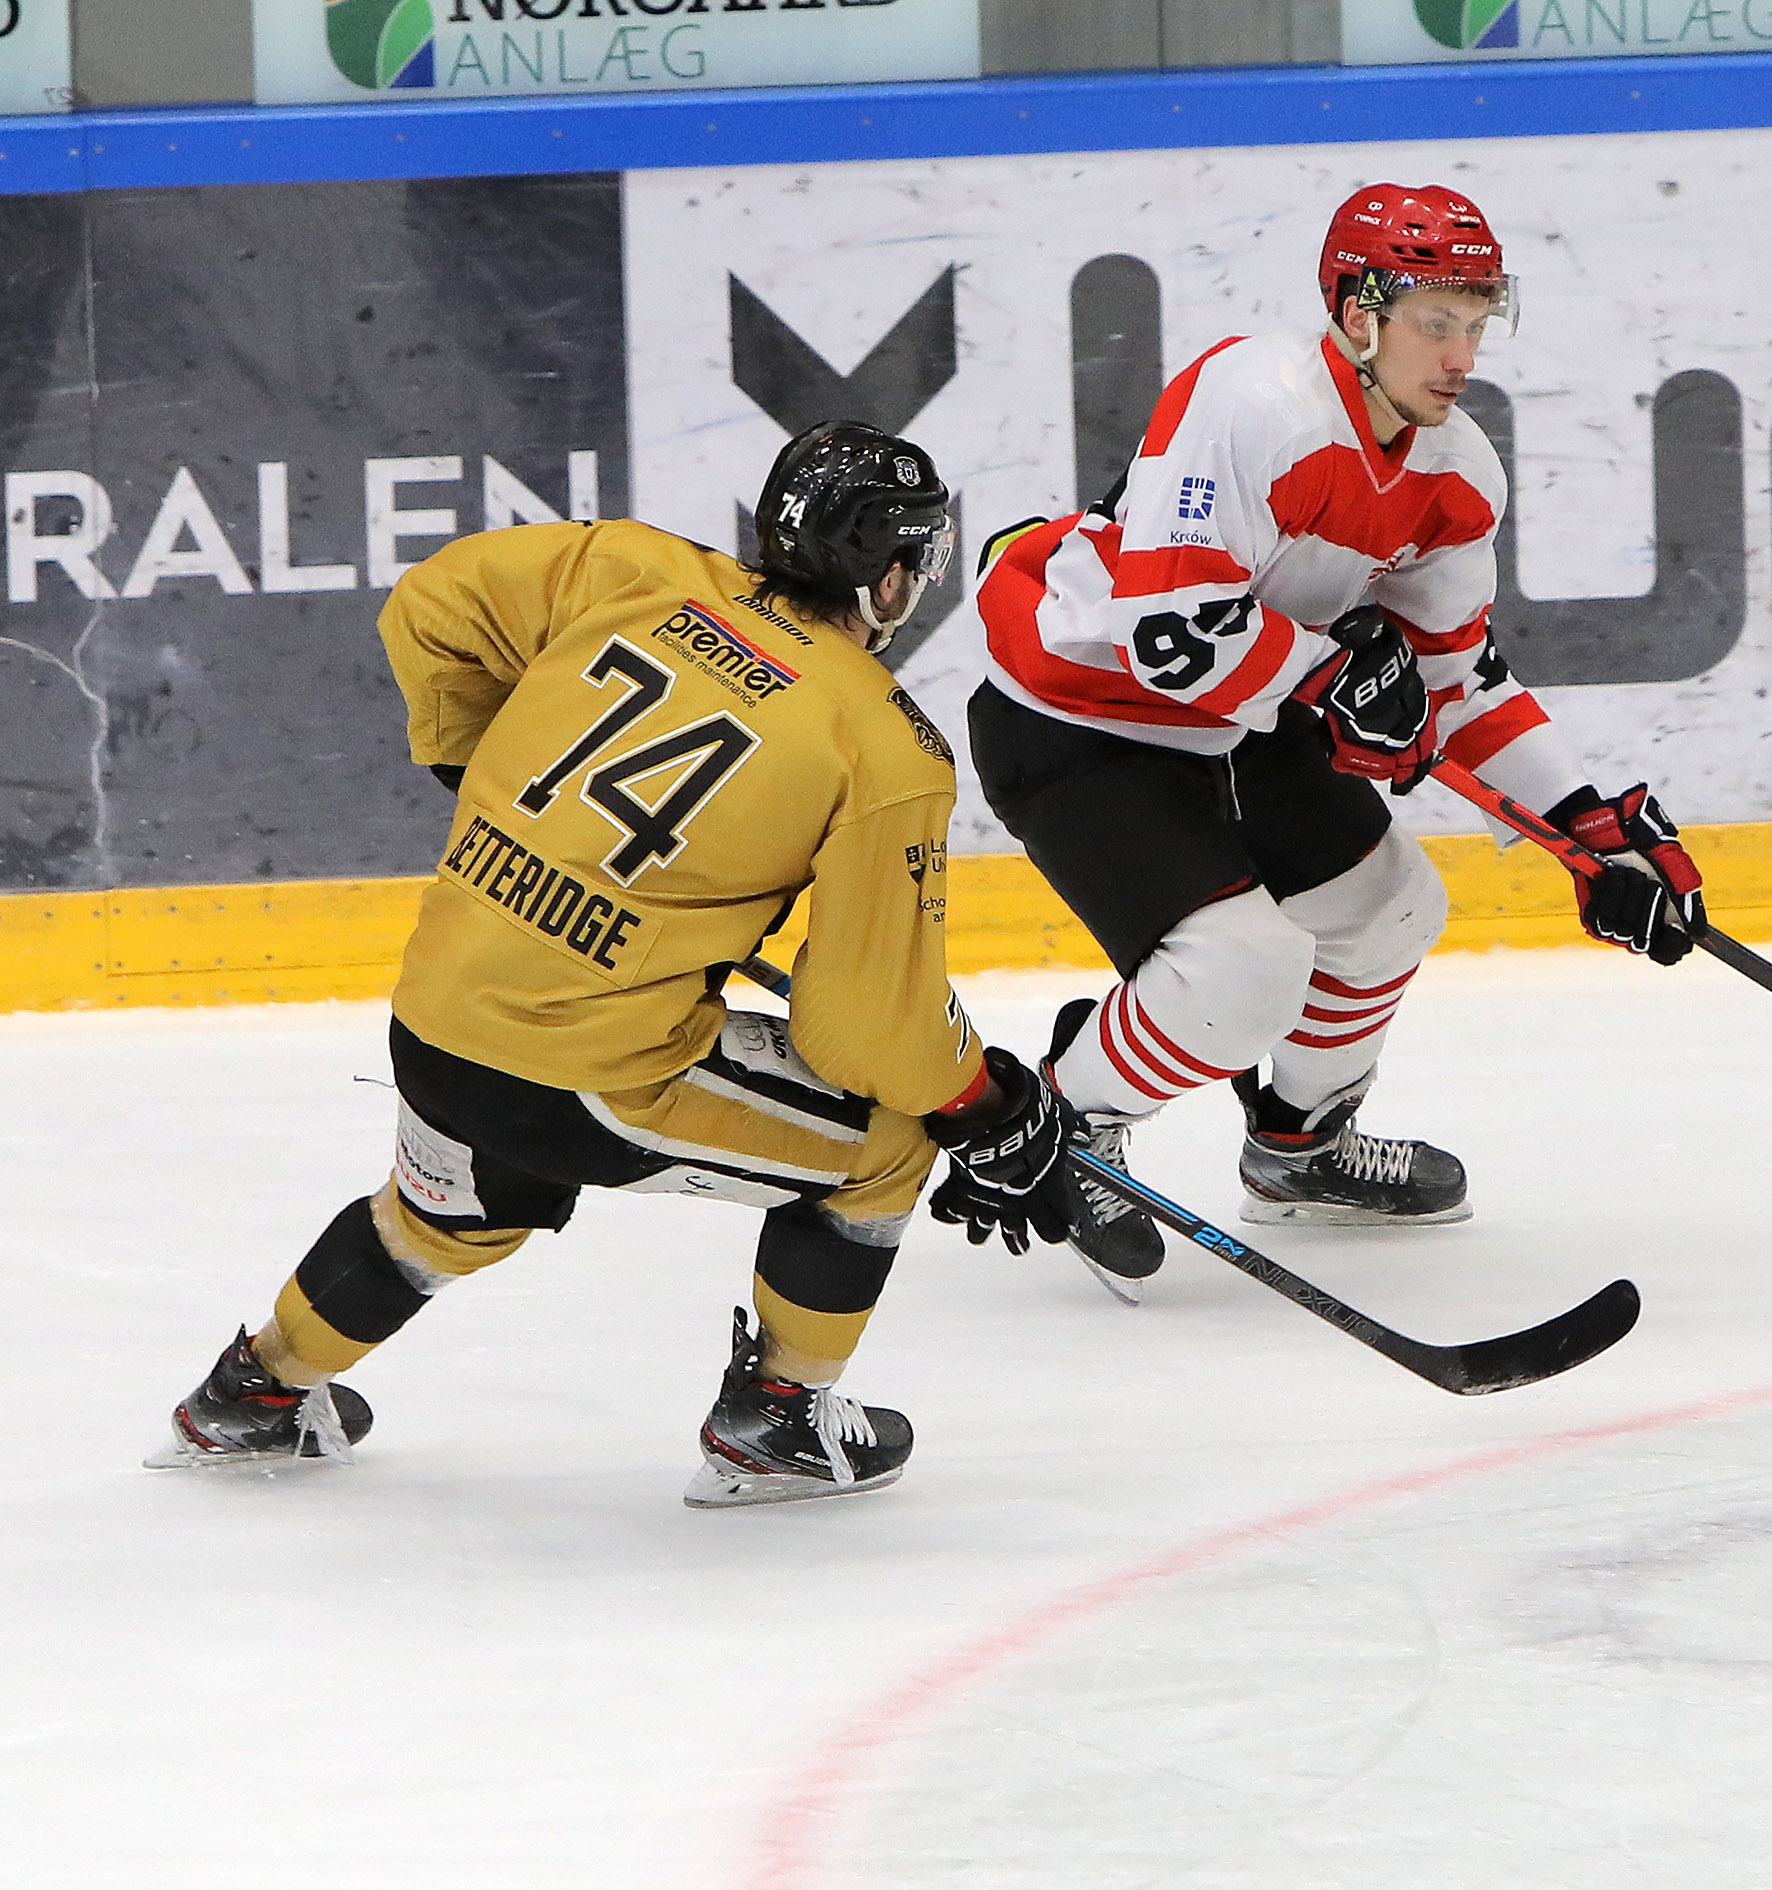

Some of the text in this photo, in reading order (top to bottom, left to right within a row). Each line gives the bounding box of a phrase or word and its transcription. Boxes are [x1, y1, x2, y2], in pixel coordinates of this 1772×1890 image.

[447, 24, 707, 88] ANLÆG
[1336, 249, 1367, 265] CCM
[1450, 243, 1493, 256] CCM
[777, 491, 807, 529] 74
[897, 525, 932, 536] CCM
[651, 611, 788, 700] premier
[657, 630, 758, 709] facilities maintenance
[1354, 634, 1414, 710] BAU
[511, 633, 764, 889] 74
[968, 1080, 1053, 1167] BAU
